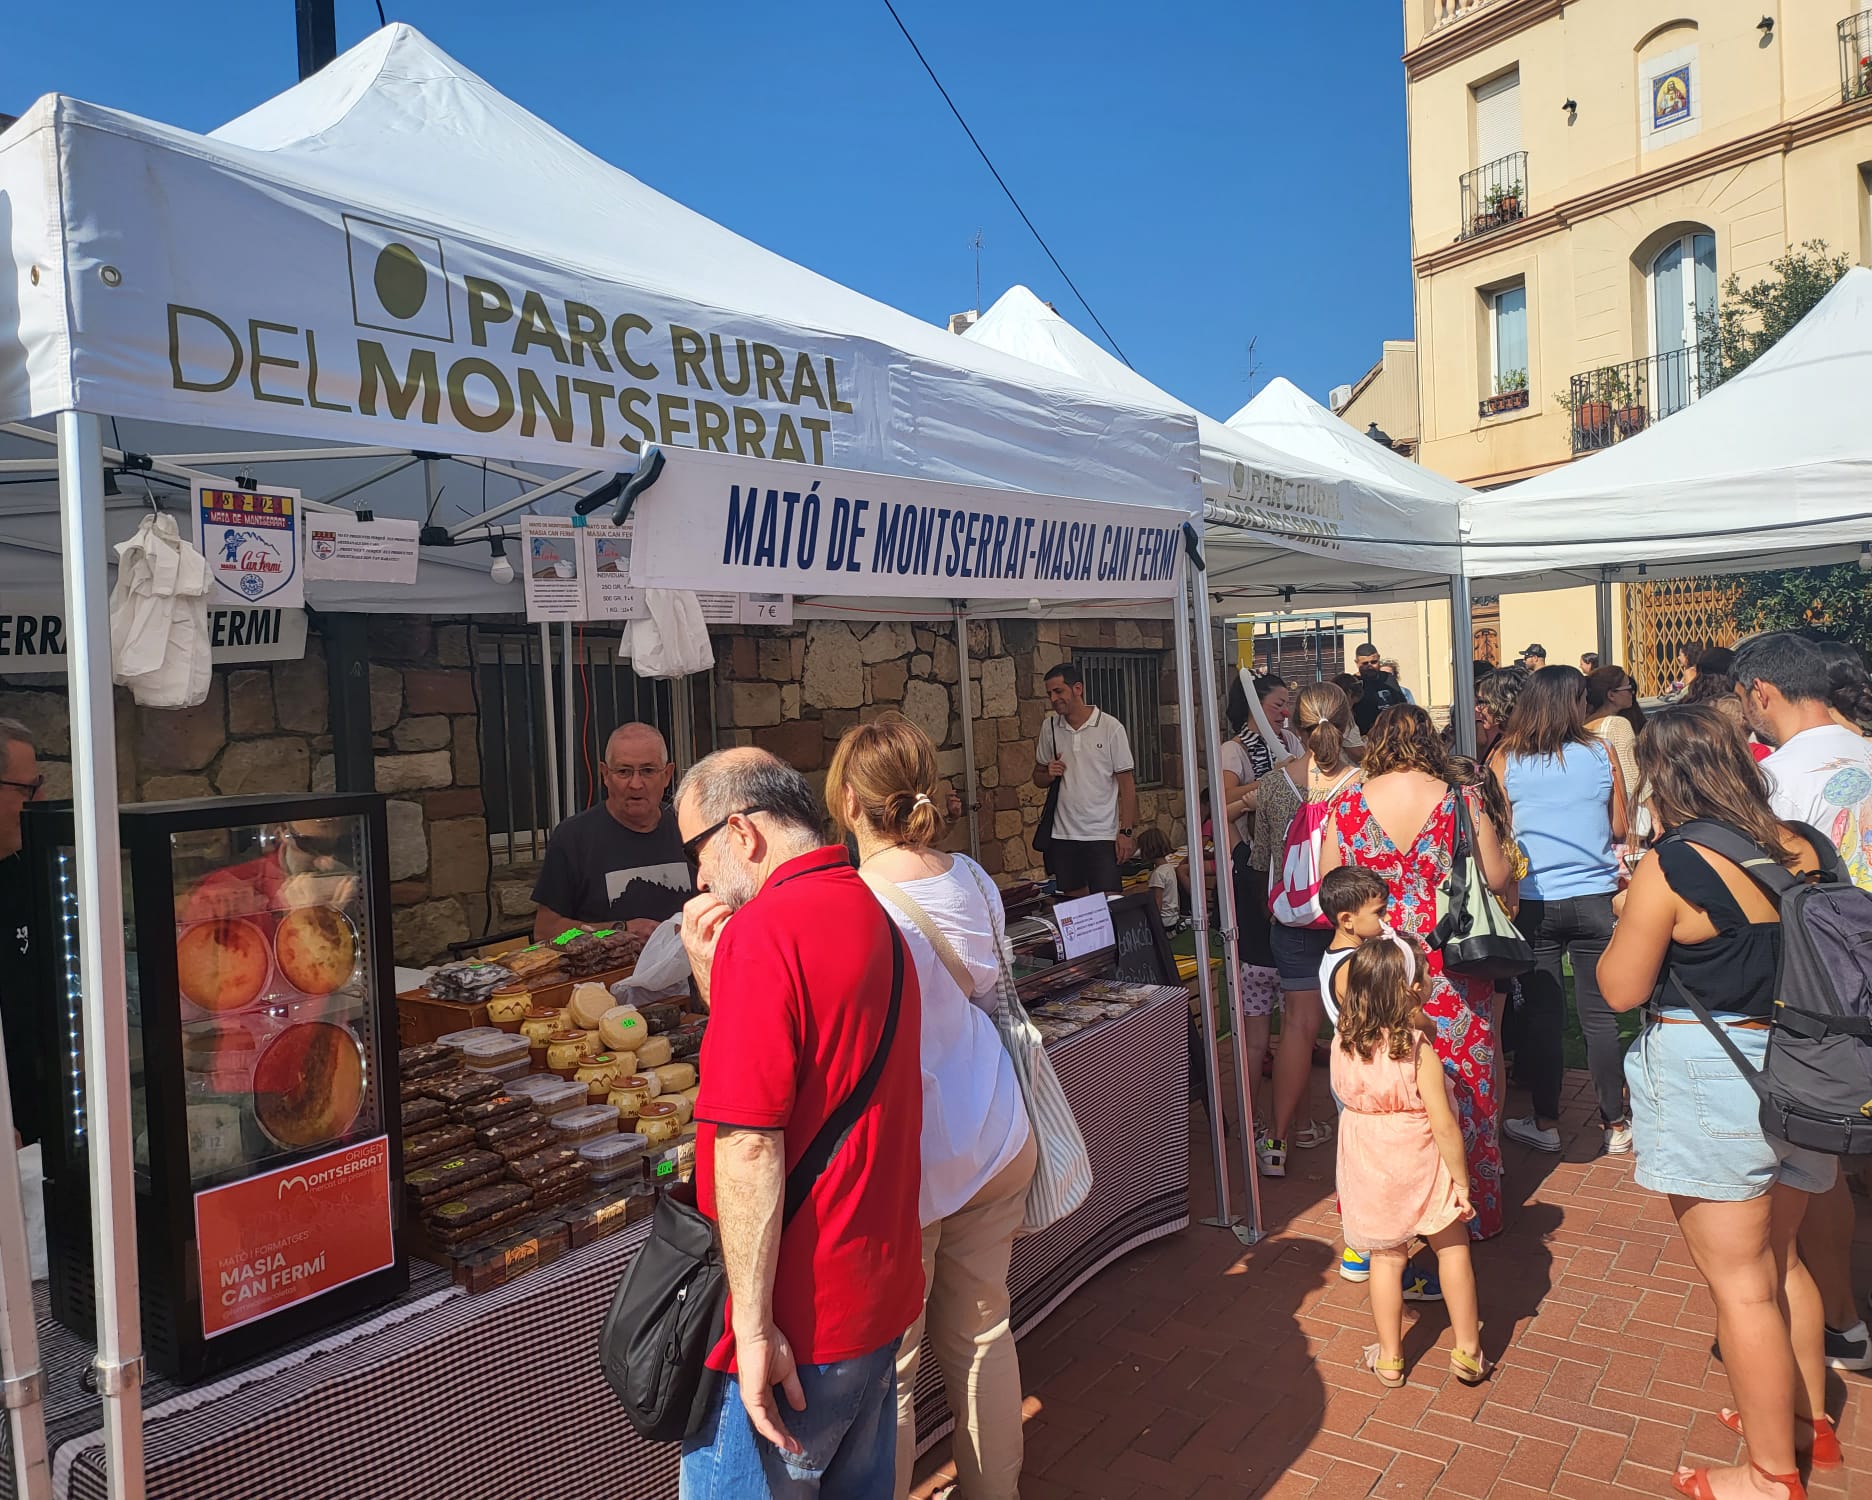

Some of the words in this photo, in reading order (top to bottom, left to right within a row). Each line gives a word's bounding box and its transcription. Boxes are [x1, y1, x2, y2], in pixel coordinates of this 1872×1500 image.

[463, 275, 660, 381] PARC
[669, 323, 853, 415] RURAL
[166, 303, 352, 413] DEL
[356, 338, 832, 466] MONTSERRAT
[722, 480, 822, 570] MATÓ
[825, 497, 870, 573] DE
[1097, 524, 1134, 582] CAN
[1131, 522, 1182, 582] FERMÍ
[207, 608, 282, 648] ERMI
[757, 604, 765, 618] 7
[768, 605, 778, 618] €
[277, 1152, 384, 1201] MONTSERRAT
[345, 1142, 384, 1162] ORIGEN
[219, 1252, 287, 1288] MASIA
[221, 1279, 268, 1307] CAN
[270, 1250, 327, 1291] FERMÍ
